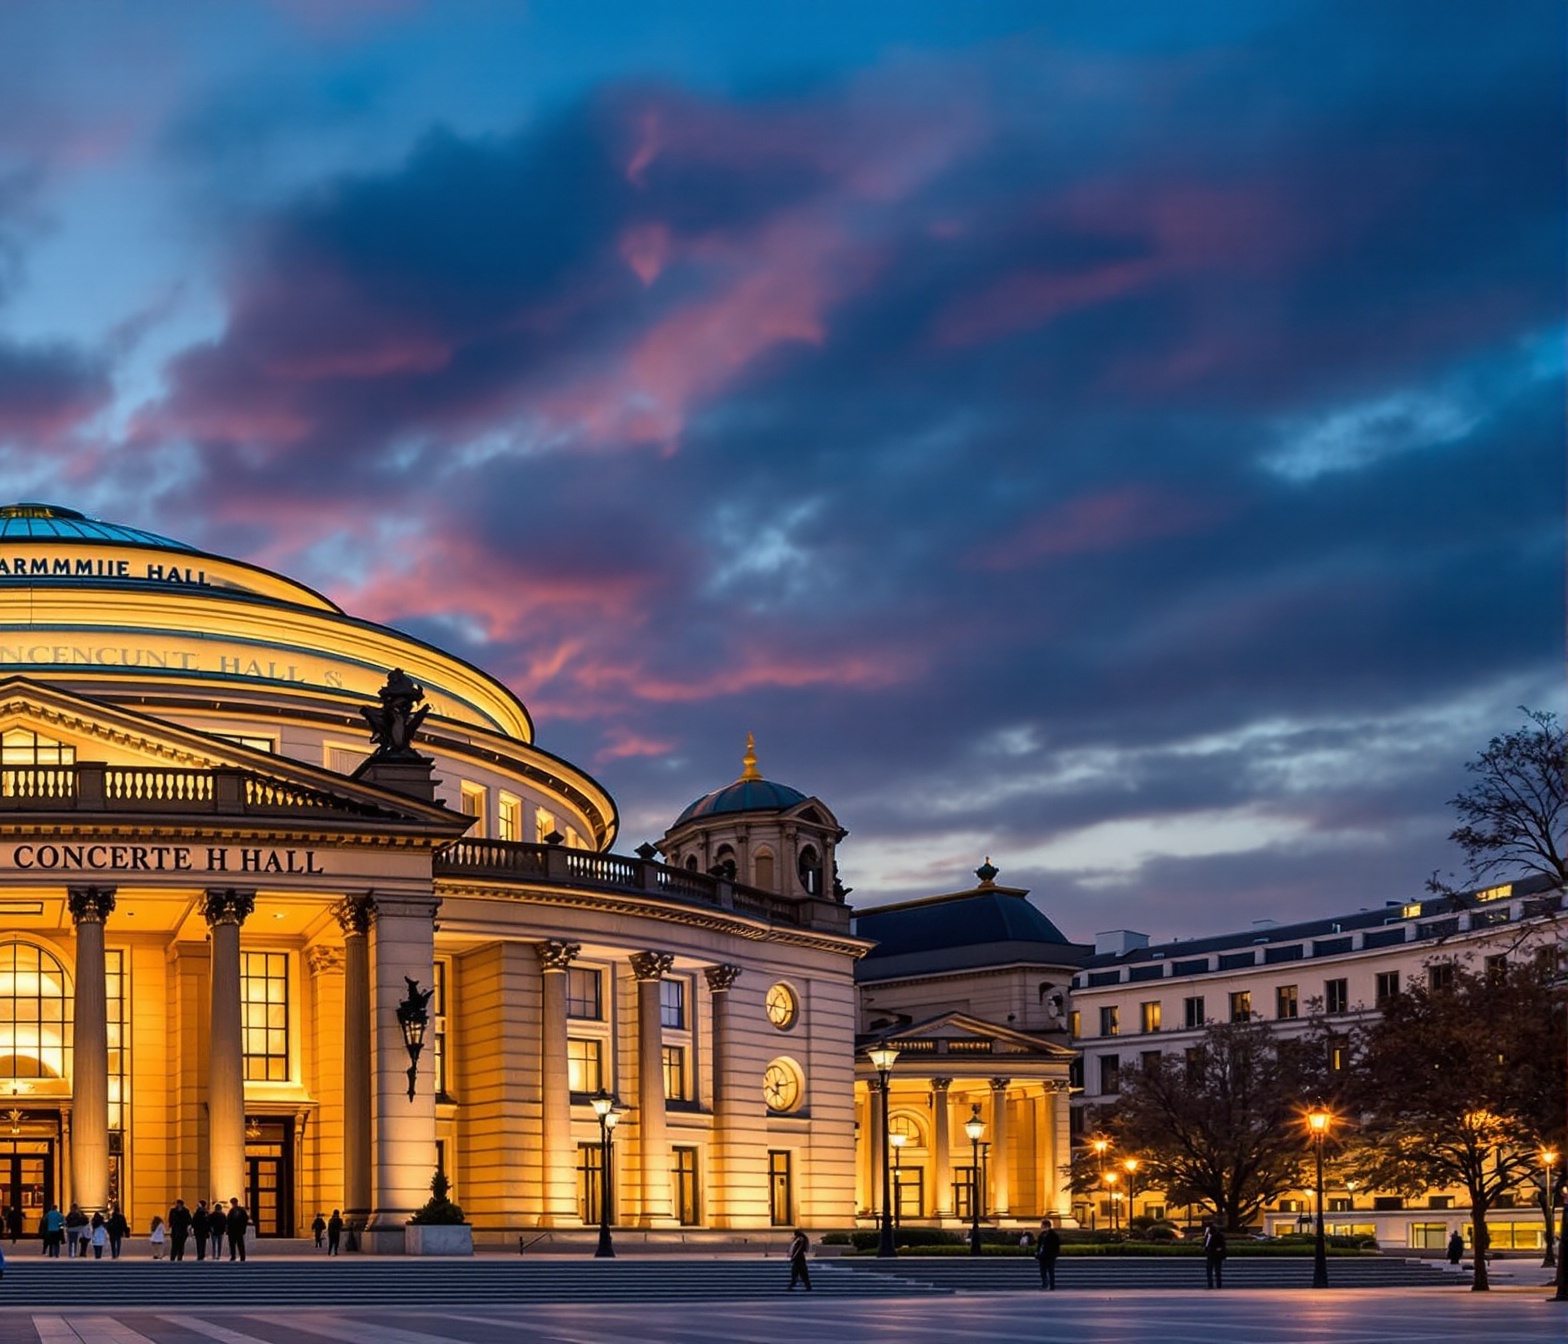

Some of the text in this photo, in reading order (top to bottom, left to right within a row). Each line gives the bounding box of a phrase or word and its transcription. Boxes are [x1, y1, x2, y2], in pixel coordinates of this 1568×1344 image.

[147, 564, 211, 586] HALL
[220, 656, 306, 683] HALL
[13, 845, 192, 871] CONCERTE
[240, 848, 324, 874] HALL
